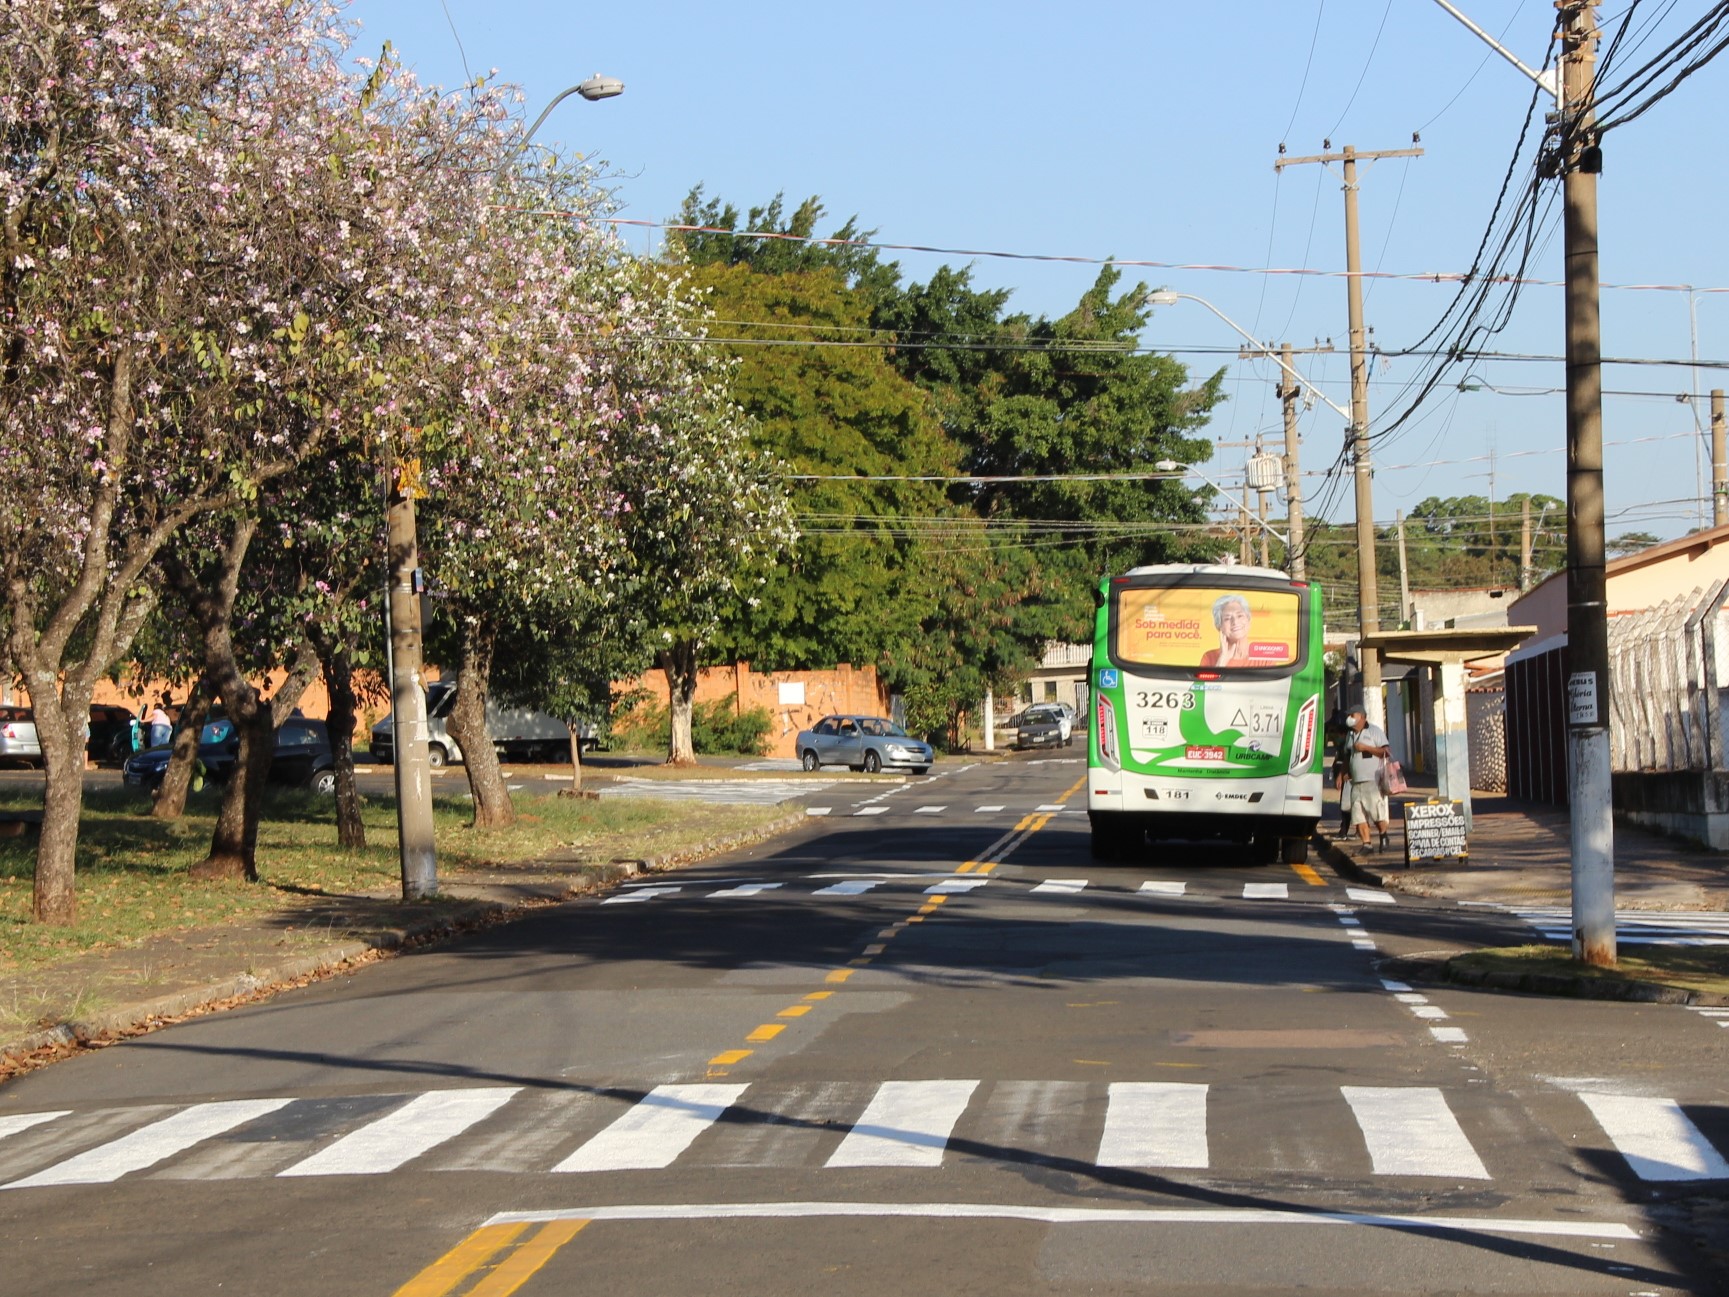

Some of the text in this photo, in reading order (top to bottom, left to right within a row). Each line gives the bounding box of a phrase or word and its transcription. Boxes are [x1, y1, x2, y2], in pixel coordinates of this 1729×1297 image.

[1135, 619, 1200, 629] Sob medida
[1146, 630, 1202, 640] para você.
[1136, 691, 1195, 709] 3263
[1253, 713, 1279, 733] 3.71
[1147, 726, 1165, 734] 118
[1165, 790, 1189, 799] 181
[1411, 804, 1455, 818] XEROX
[1408, 816, 1464, 829] IMPRESSÕES
[1431, 837, 1440, 848] DE
[1440, 835, 1466, 847] CONTAS
